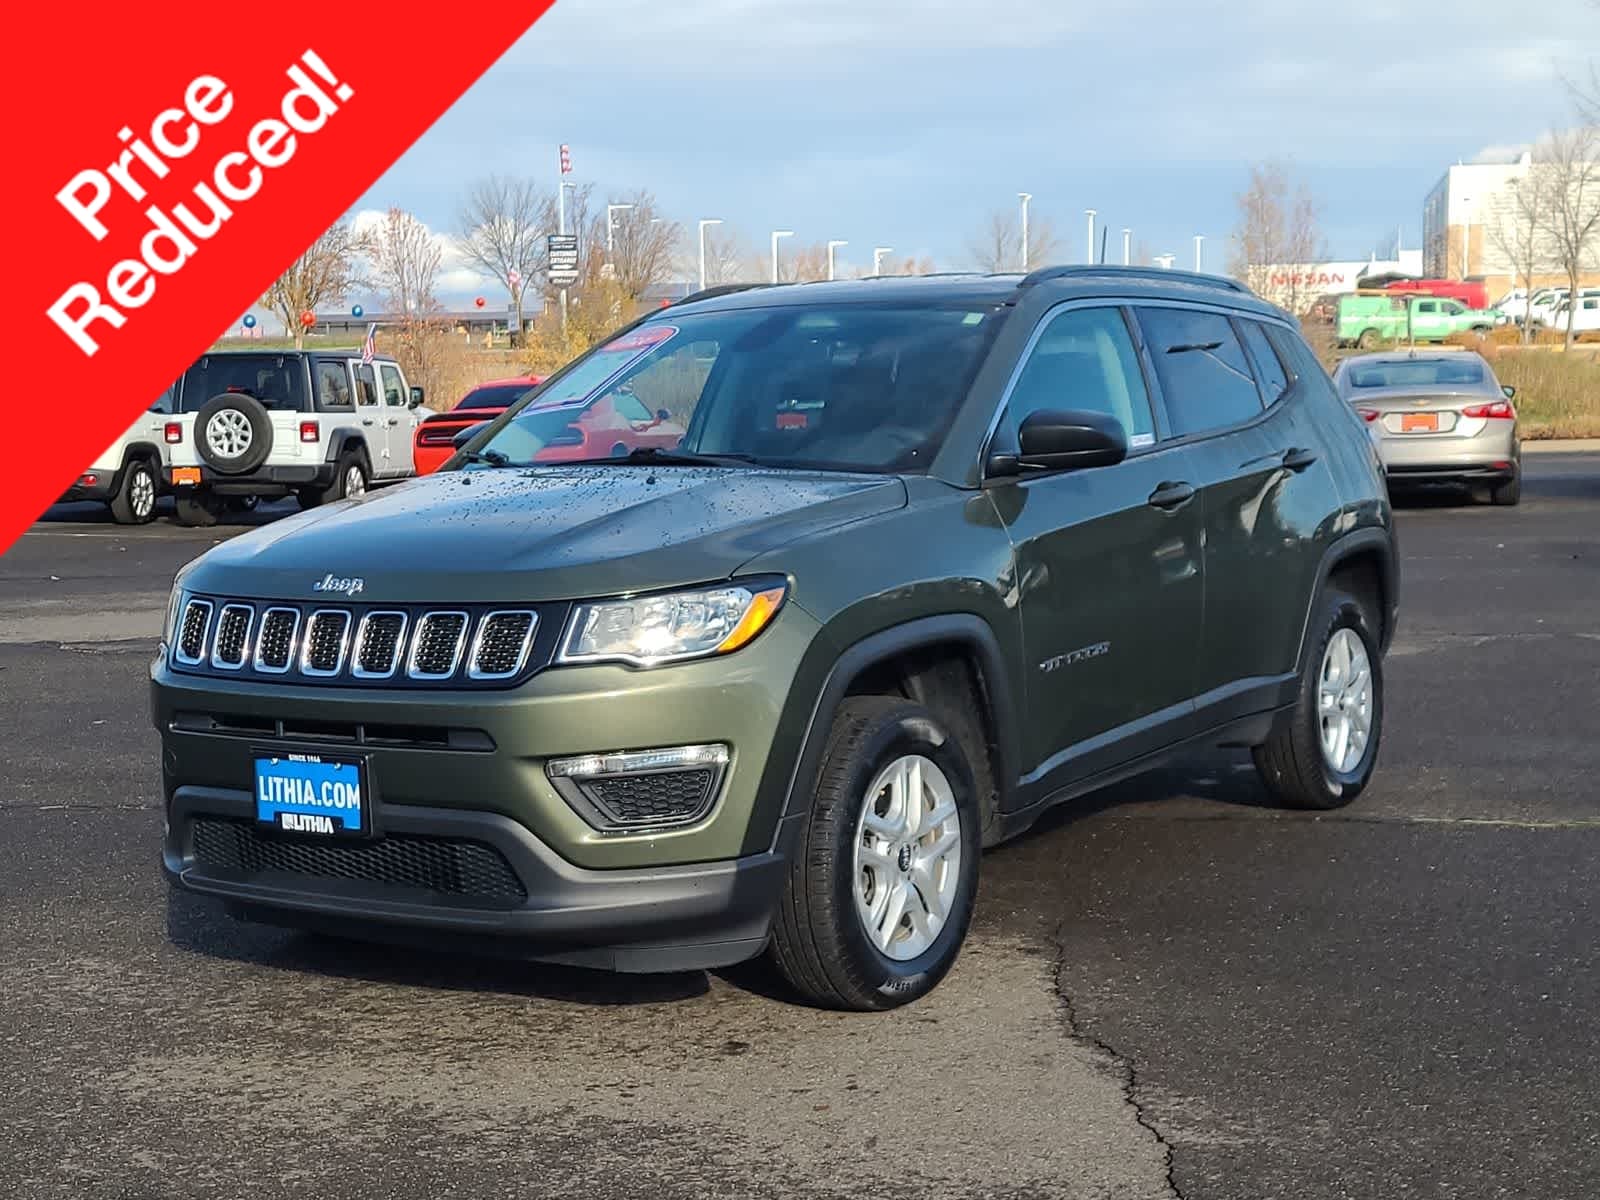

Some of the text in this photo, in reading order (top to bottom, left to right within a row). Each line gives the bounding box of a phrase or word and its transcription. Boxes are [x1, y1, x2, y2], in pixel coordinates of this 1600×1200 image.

[1270, 271, 1345, 287] NISSAN
[313, 573, 364, 597] Jeep
[259, 775, 361, 811] LITHIA.COM
[294, 815, 335, 834] LITHIA
